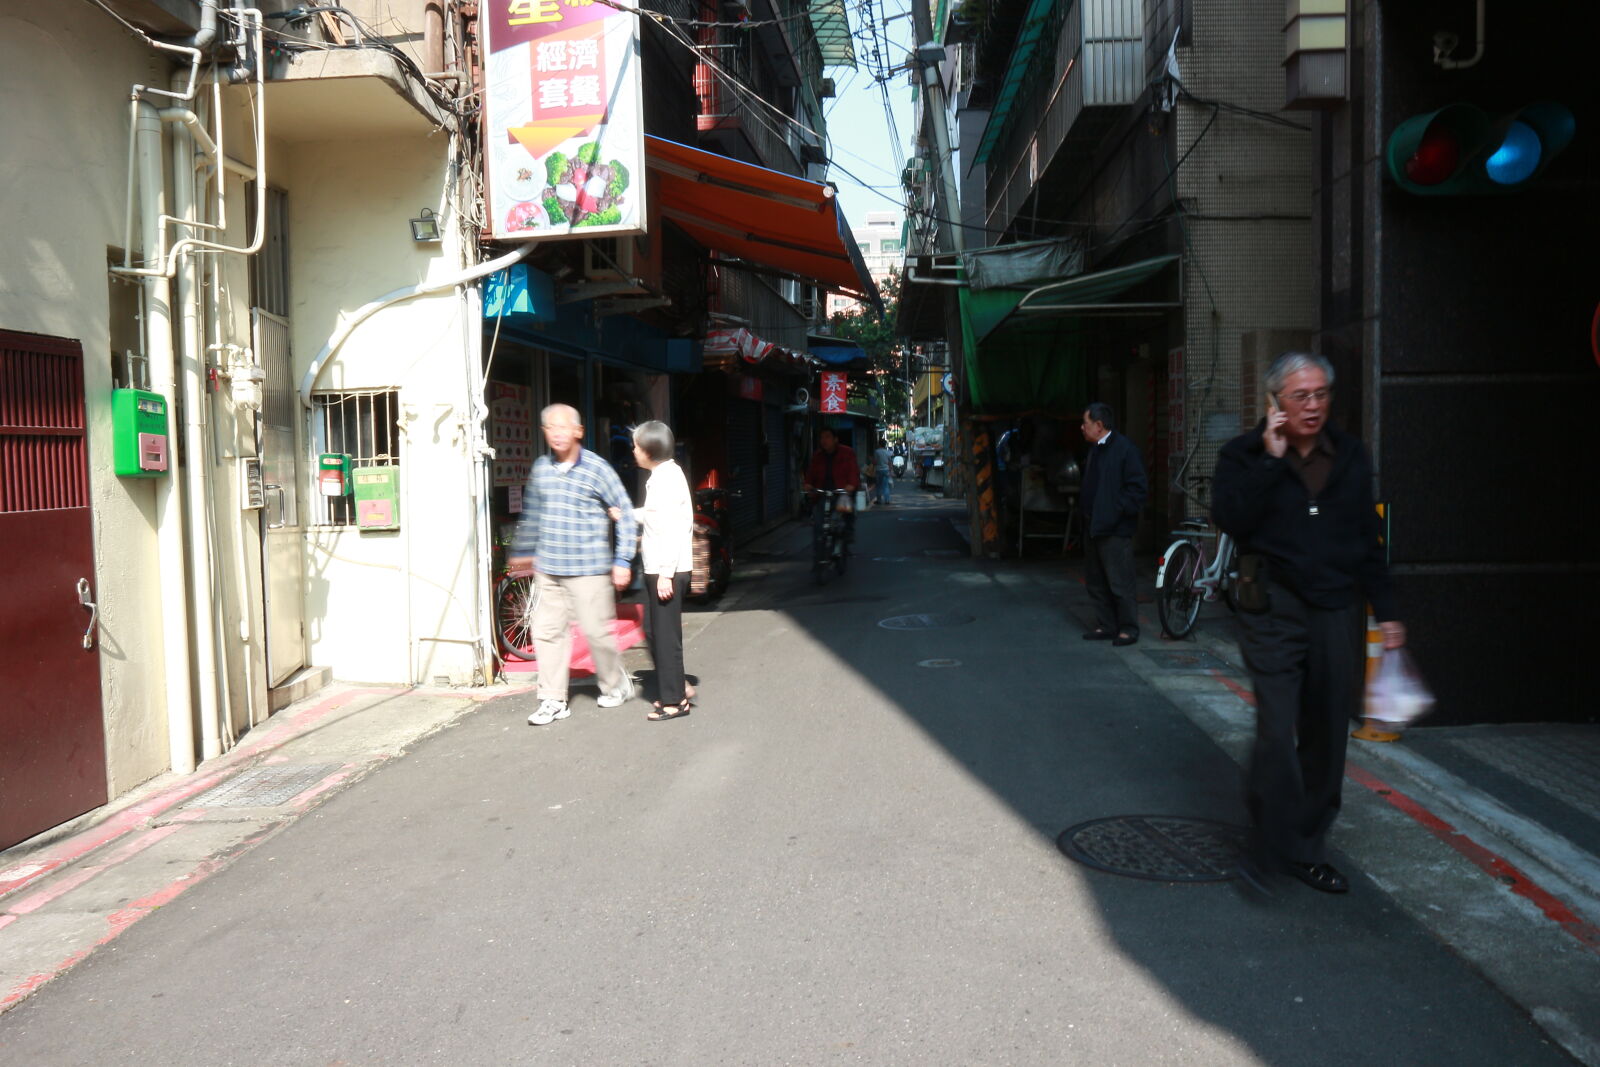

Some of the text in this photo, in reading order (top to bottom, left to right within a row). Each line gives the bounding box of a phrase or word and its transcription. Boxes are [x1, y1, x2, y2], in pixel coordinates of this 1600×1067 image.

[536, 39, 599, 72] 經濟
[538, 75, 602, 109] 套餐
[822, 374, 845, 411] 素食
